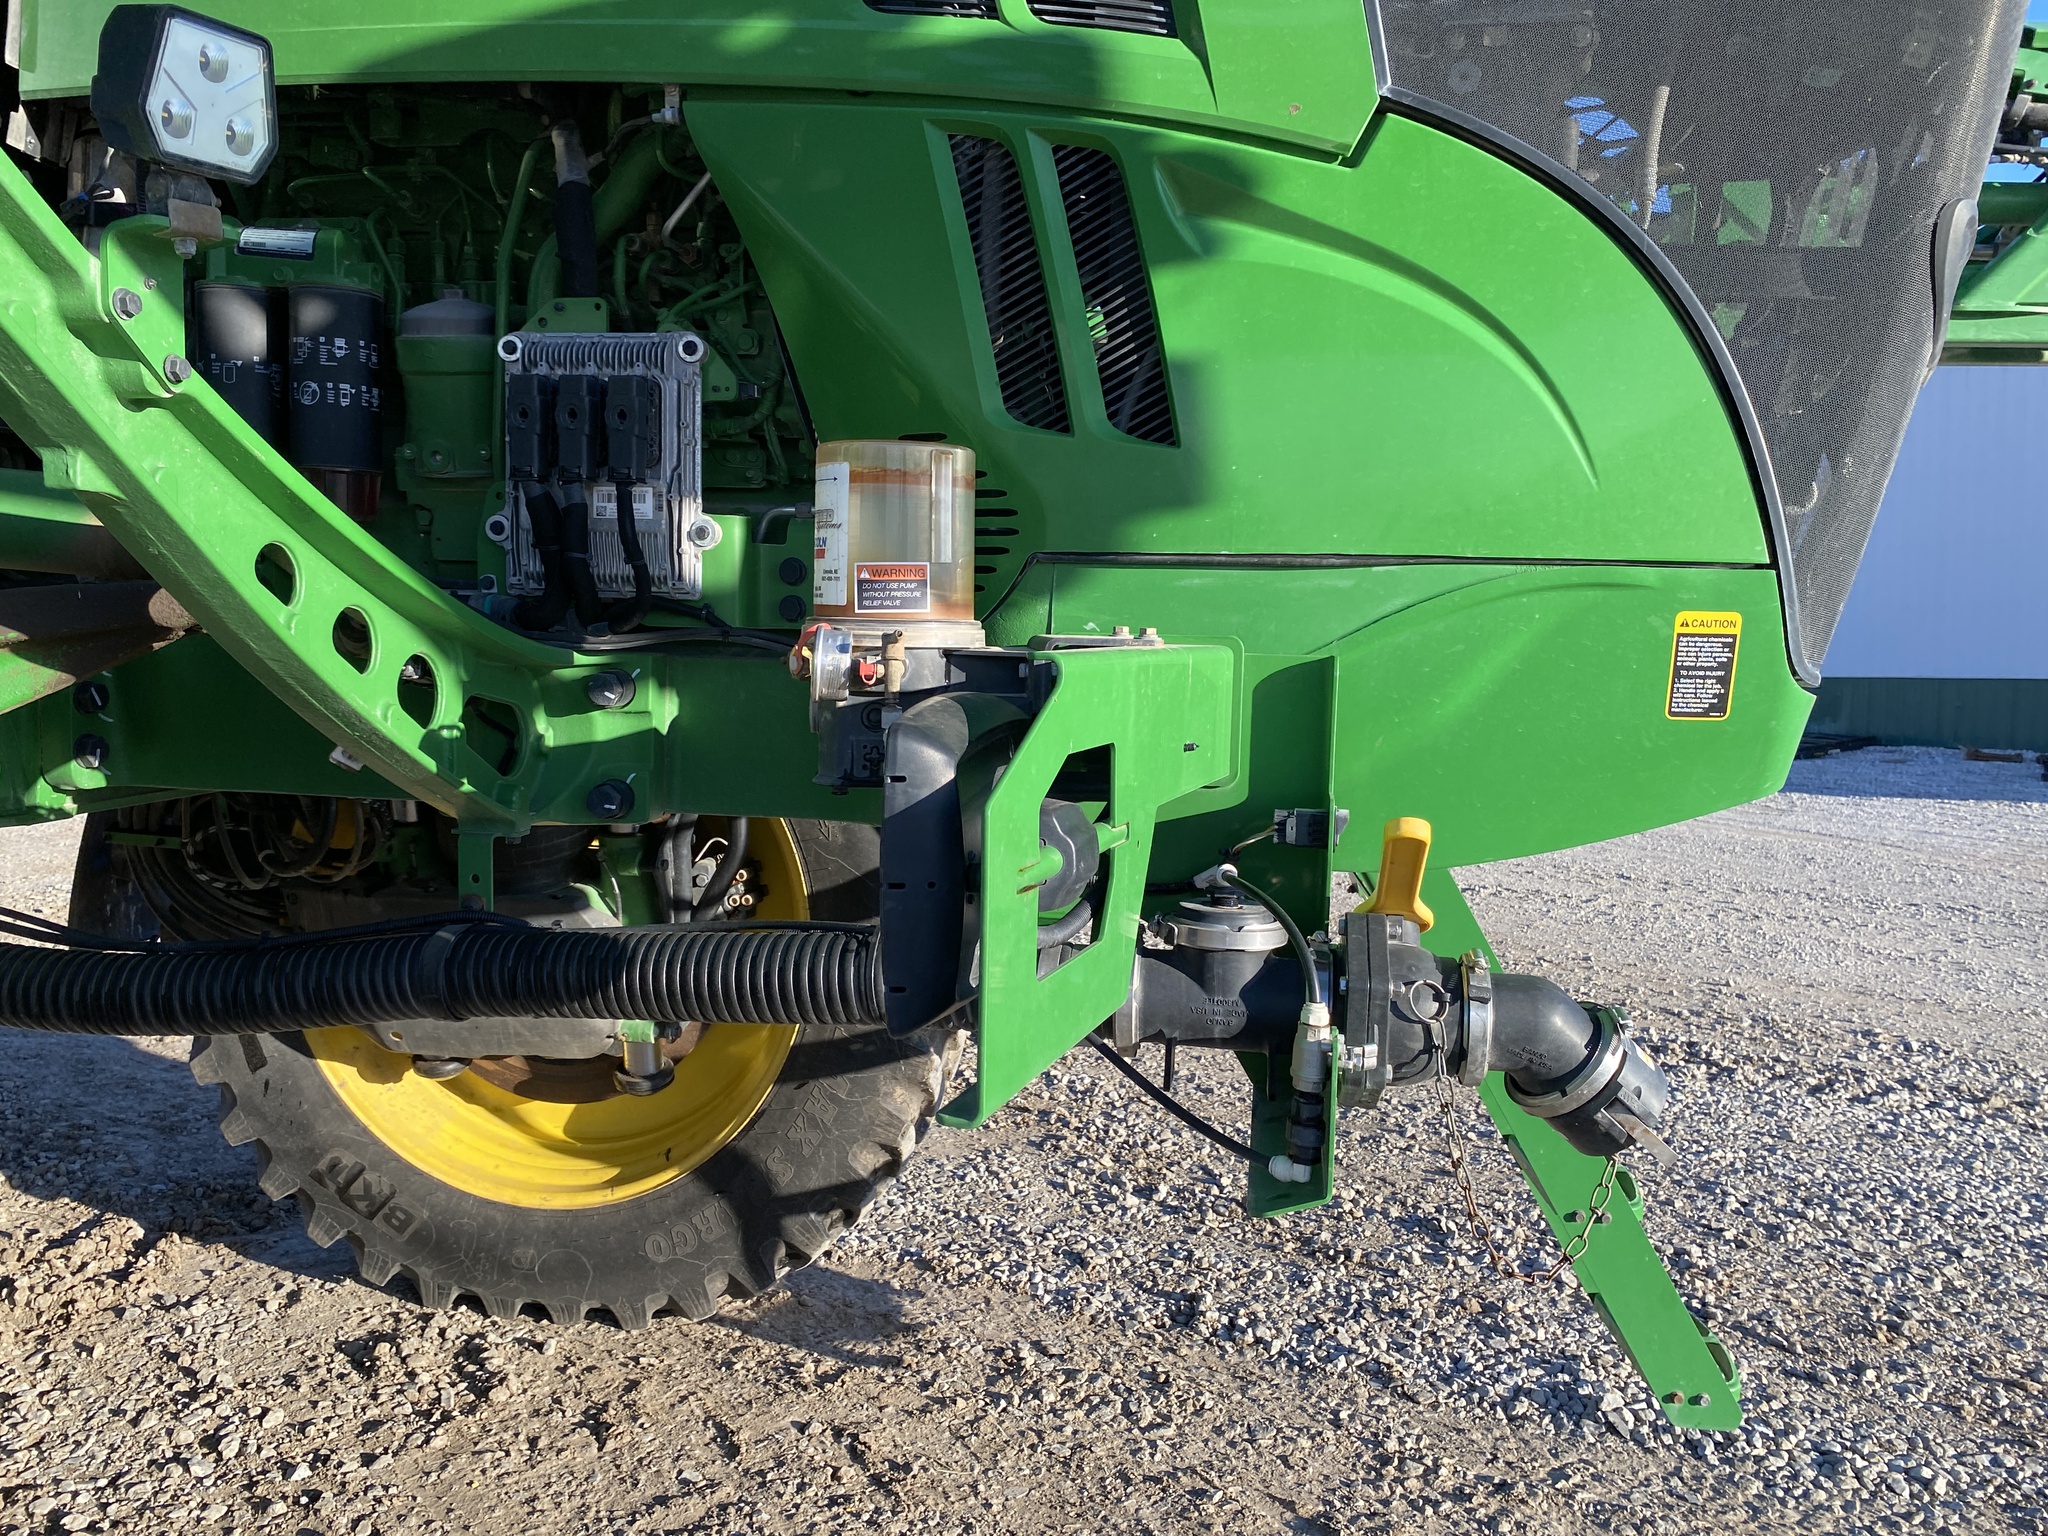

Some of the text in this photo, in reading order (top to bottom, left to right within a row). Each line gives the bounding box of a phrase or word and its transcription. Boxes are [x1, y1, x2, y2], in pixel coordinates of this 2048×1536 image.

[872, 569, 925, 578] WARNING
[1692, 619, 1736, 628] CAUTION
[1190, 1006, 1207, 1014] USA
[308, 1151, 420, 1239] BKT
